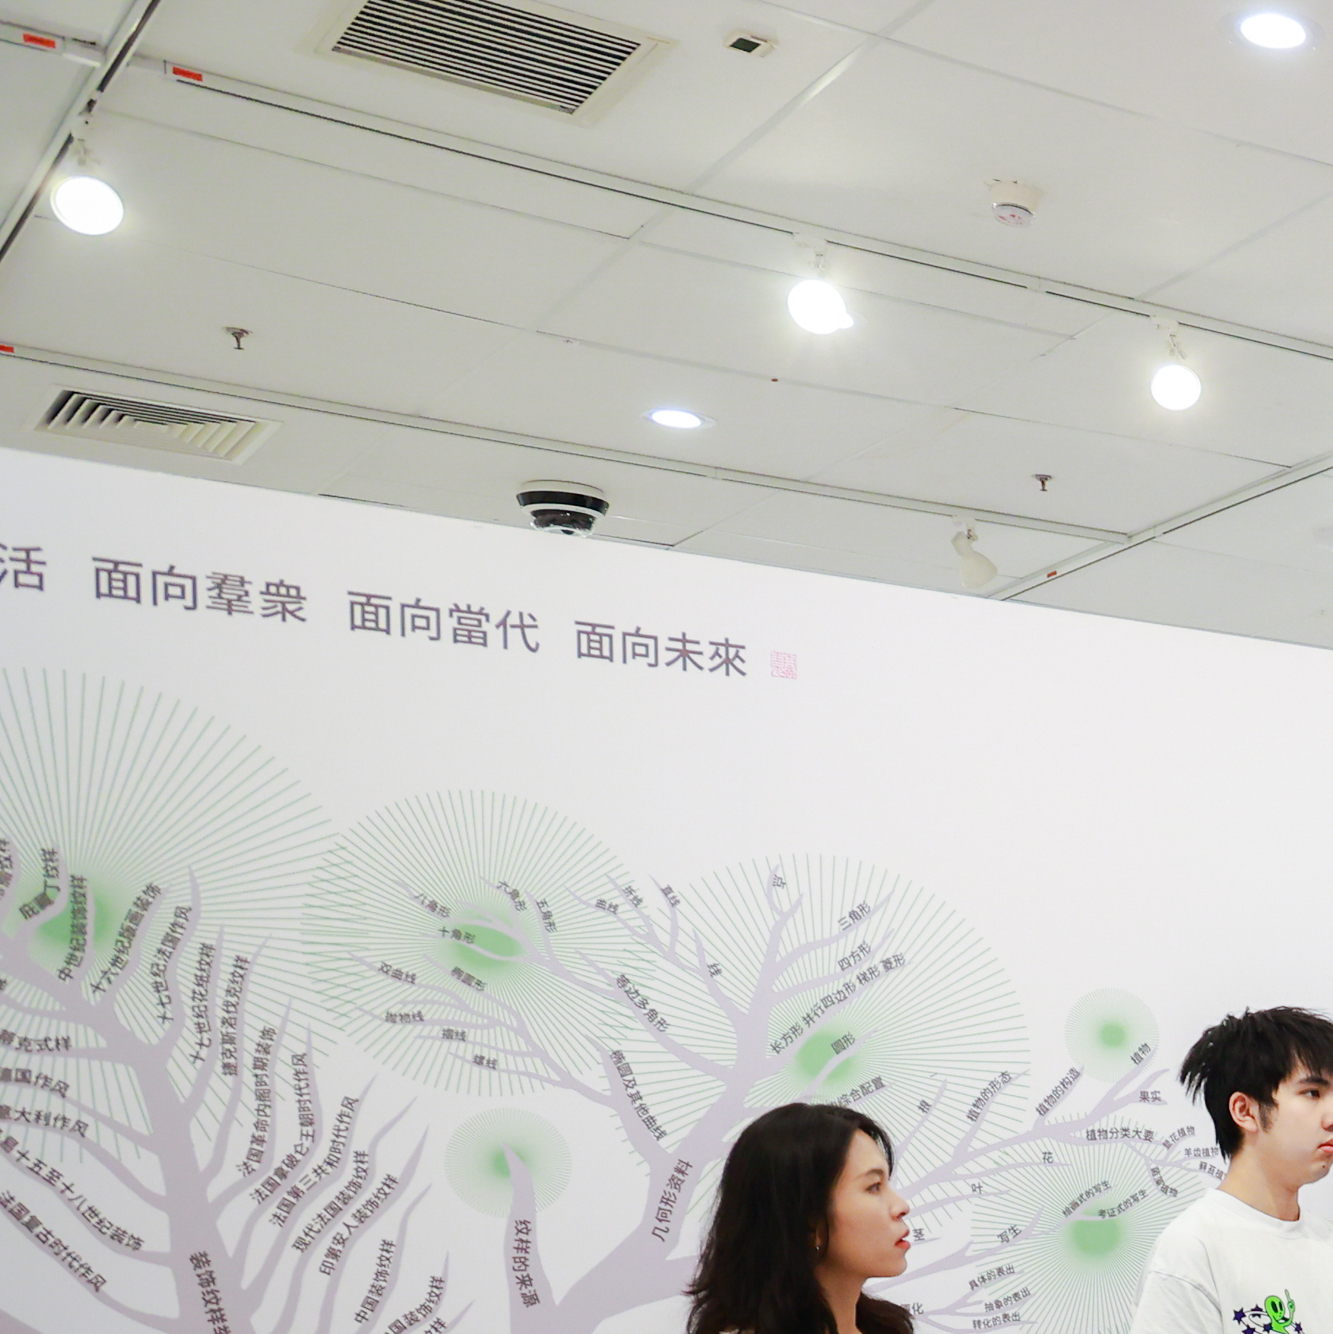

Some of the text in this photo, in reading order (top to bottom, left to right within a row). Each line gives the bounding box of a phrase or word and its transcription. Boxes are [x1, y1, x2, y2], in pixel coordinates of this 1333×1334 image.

[347, 590, 540, 654] 面向當代
[574, 620, 747, 677] 面向未來
[772, 875, 786, 890] 点
[414, 892, 451, 918] 八角形
[536, 898, 557, 934] 五角形
[837, 901, 871, 931] 三角形
[438, 925, 476, 944] 十角形
[150, 905, 192, 1025] 十七世纪法国作风
[378, 961, 417, 985] 双曲线
[707, 962, 723, 978] 线
[837, 940, 872, 972] 四方形
[221, 955, 251, 1077] 捷克斯洛伐克纹样
[616, 973, 672, 1033] 等边多角形
[769, 951, 907, 1056] 长方形 并行四边形 梯形 菱形
[830, 1031, 857, 1055] 圆形
[1130, 1042, 1152, 1066] 植物
[236, 1026, 277, 1178] 法国革命内阁时期装饰
[609, 1049, 668, 1142] 椭圆及其他曲线
[917, 1100, 932, 1114] 根
[966, 1070, 1013, 1123] 植物的形态
[1034, 1066, 1082, 1118] 植物的构造
[1139, 1090, 1162, 1103] 果实
[249, 1052, 315, 1205] 法国拿破仑王朝时代作风
[269, 1095, 359, 1228] 法国第三共和时代作风
[1042, 1151, 1054, 1164] 花
[1199, 1161, 1227, 1180] 藓苔植
[291, 1149, 369, 1253] 现代法国装饰纹样
[652, 1158, 694, 1243] 几何形资料
[971, 1183, 983, 1194] 叶
[319, 1173, 399, 1276] 印第安人装饰纹样
[997, 1224, 1022, 1245] 写生
[512, 1219, 540, 1308] 纹样的来源
[968, 1264, 1016, 1291] 具体的表出
[354, 1239, 396, 1325] 中国装饰纹样
[972, 1311, 1021, 1330] 转化的表出
